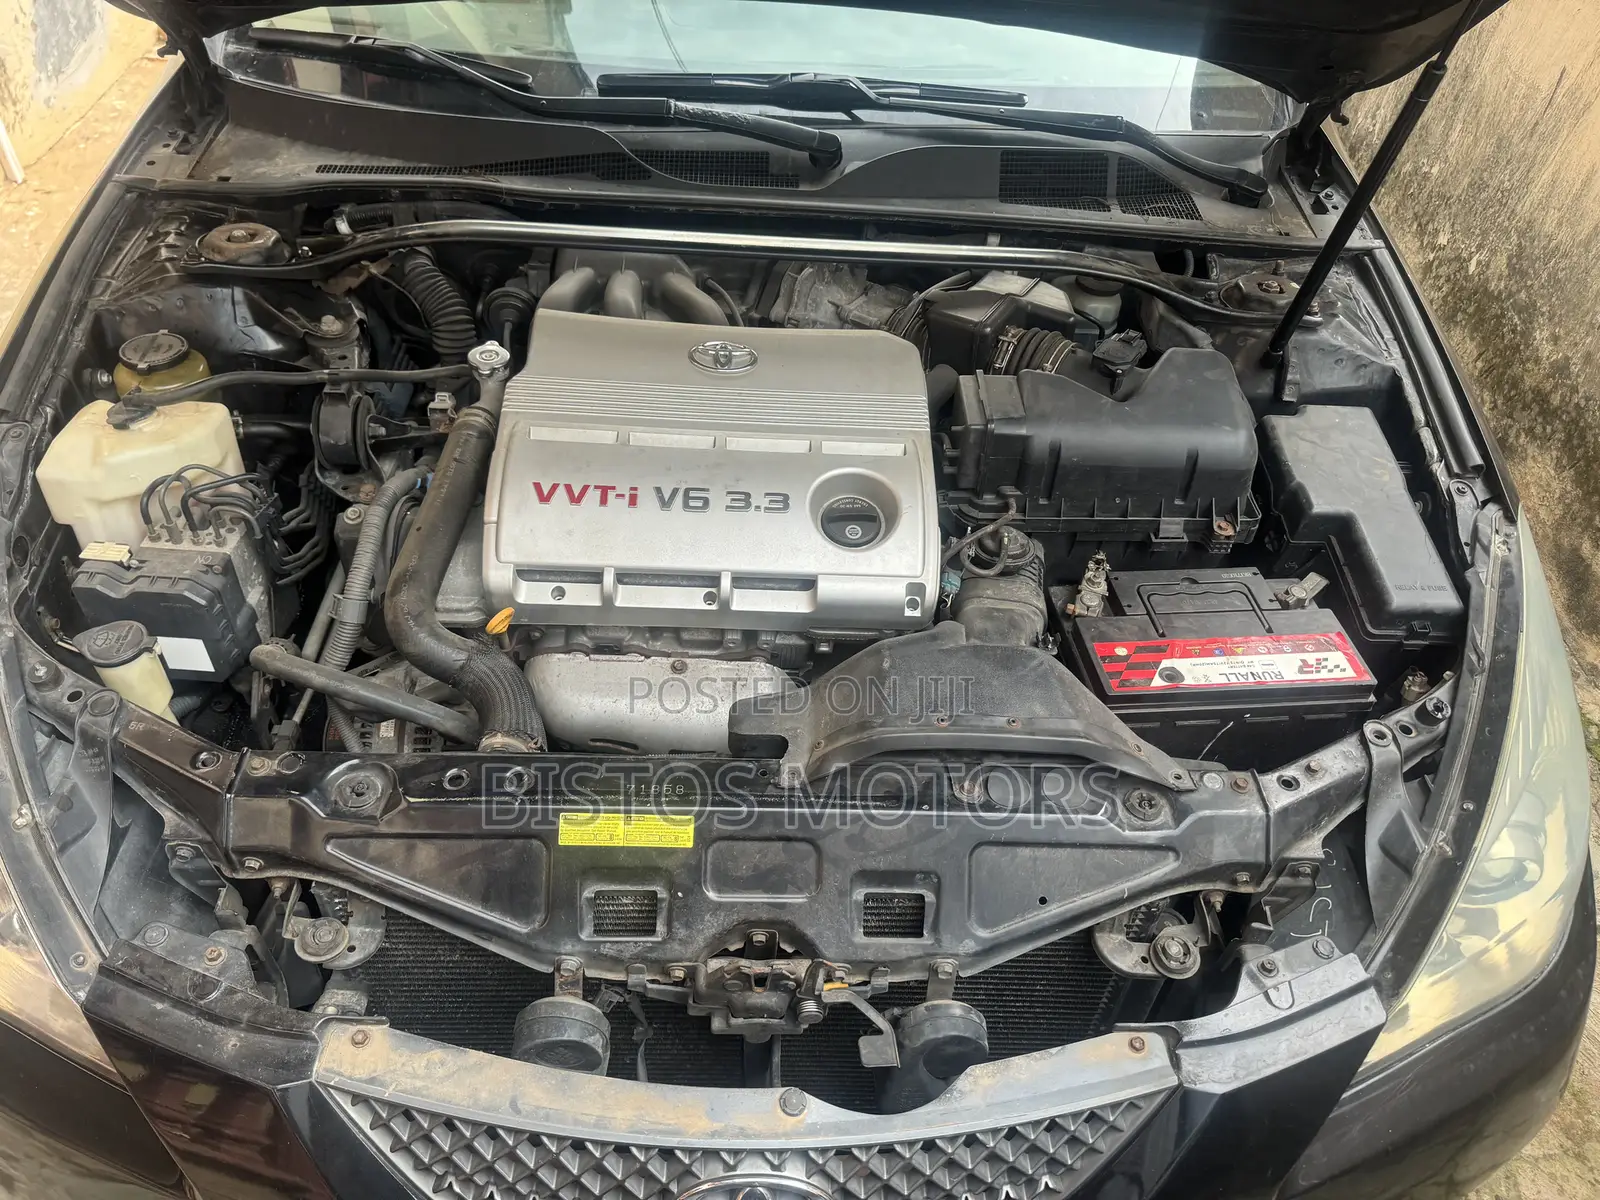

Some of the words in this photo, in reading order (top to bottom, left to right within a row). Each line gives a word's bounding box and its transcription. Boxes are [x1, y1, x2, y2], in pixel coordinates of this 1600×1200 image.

[532, 481, 640, 509] VVT-i
[652, 486, 711, 513] V6
[725, 490, 792, 514] 3.3
[1218, 669, 1285, 681] RUNALL
